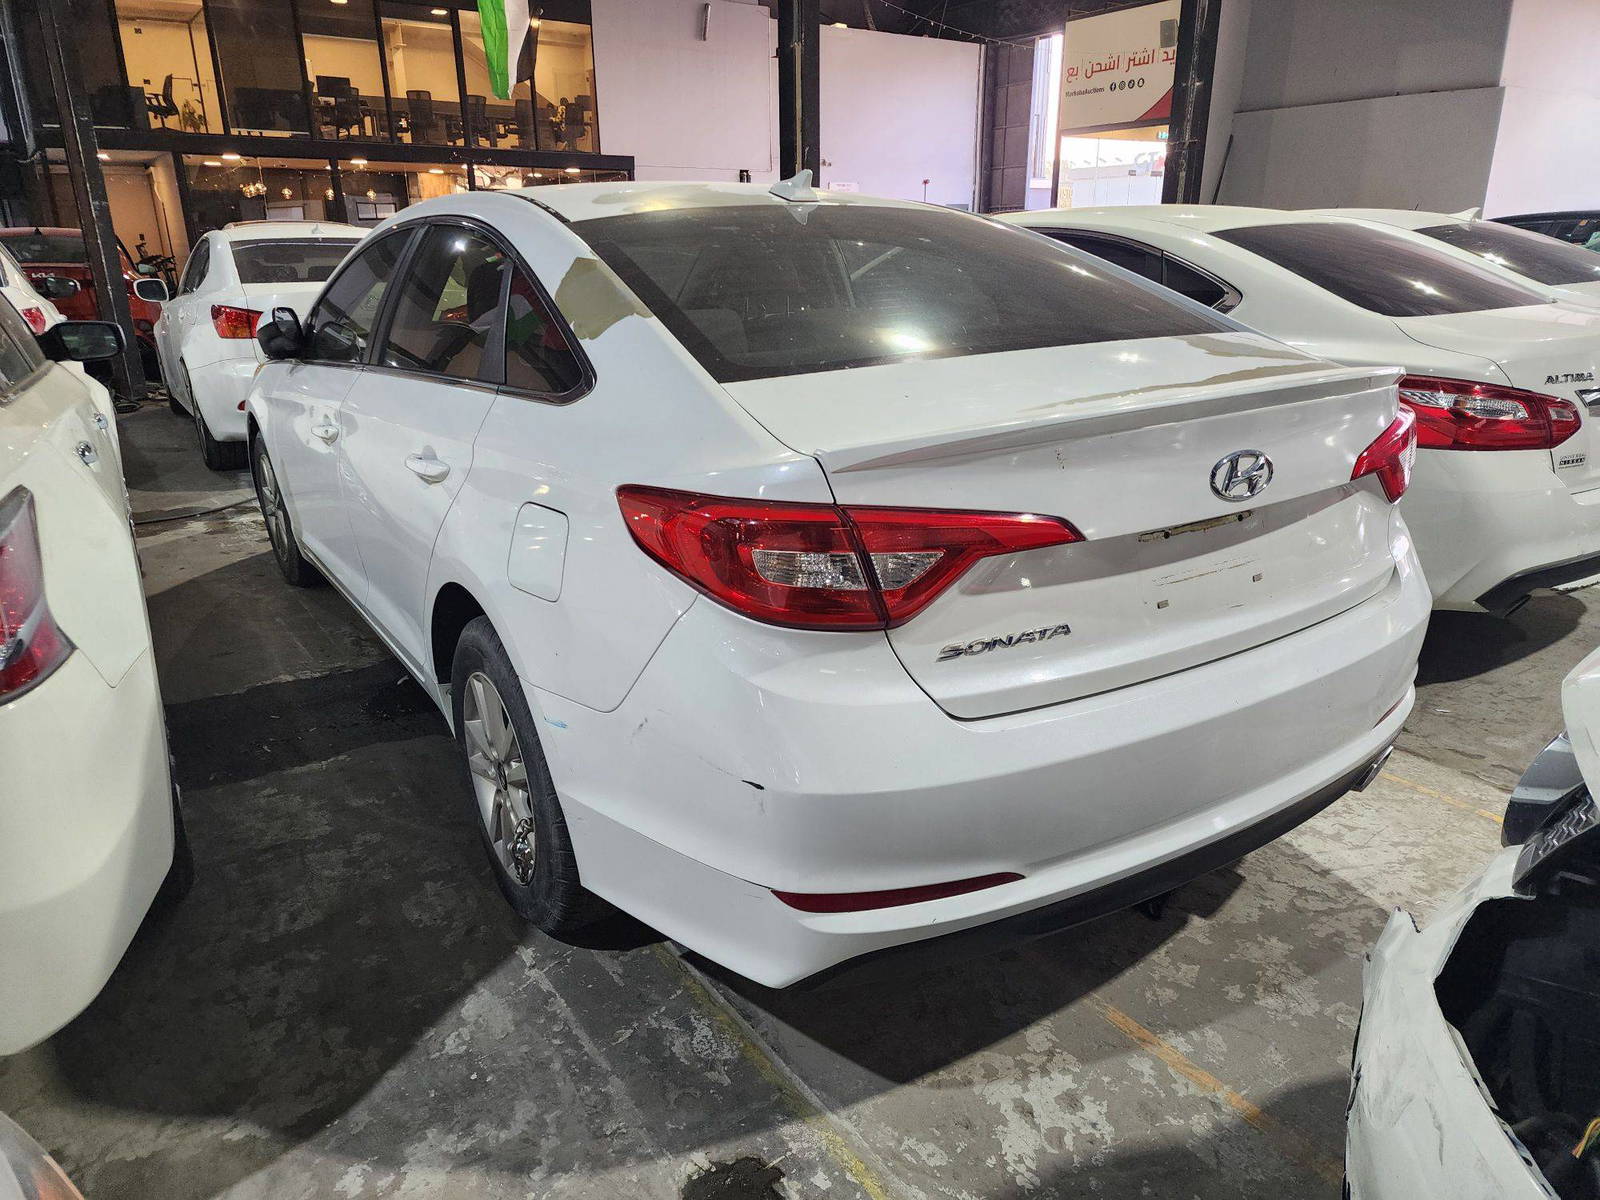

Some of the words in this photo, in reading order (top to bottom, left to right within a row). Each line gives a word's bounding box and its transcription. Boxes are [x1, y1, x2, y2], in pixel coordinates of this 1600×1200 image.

[1085, 53, 1120, 79] اشحن
[1125, 47, 1155, 73] اشتر
[1066, 65, 1079, 83] بع
[1544, 372, 1594, 385] ALTIMA
[936, 623, 1072, 662] SONATA
